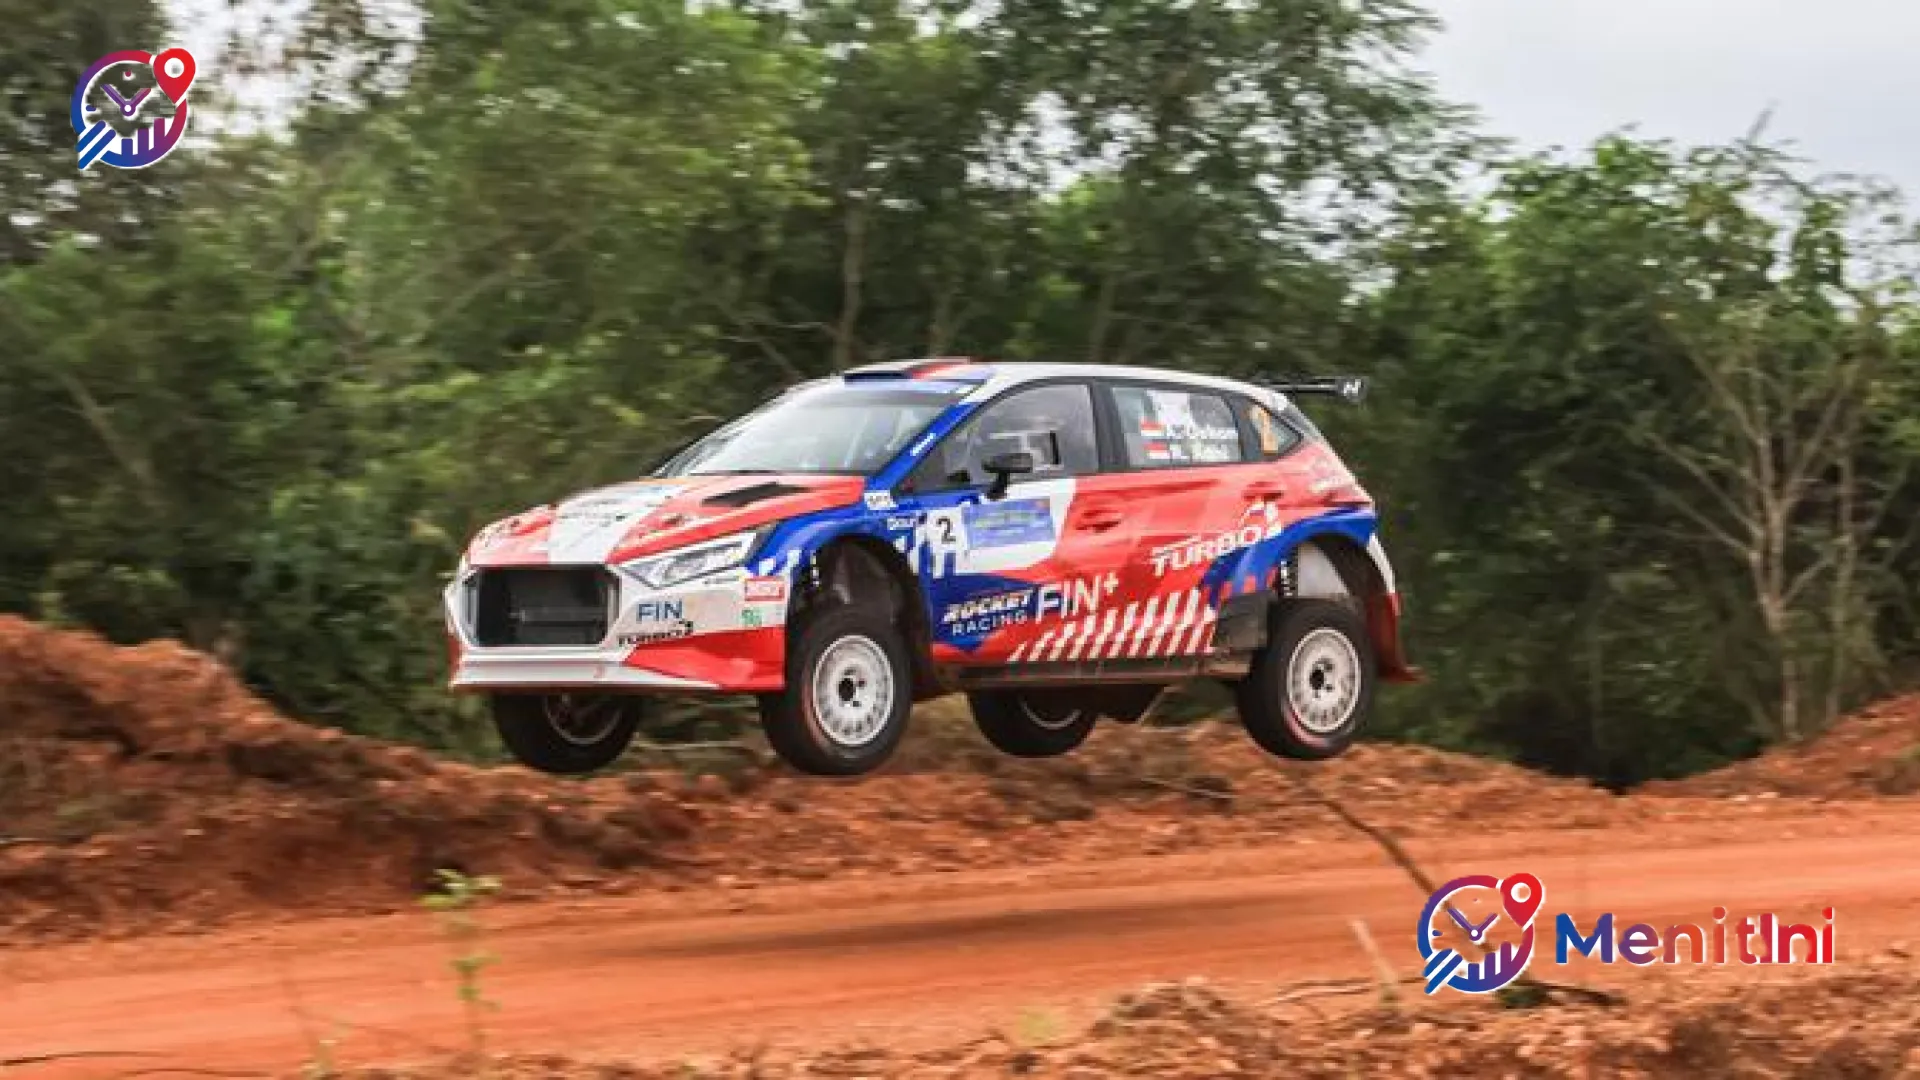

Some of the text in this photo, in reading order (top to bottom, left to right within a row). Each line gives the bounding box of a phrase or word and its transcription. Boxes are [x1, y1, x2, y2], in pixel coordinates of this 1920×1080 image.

[936, 516, 957, 544] 2
[1152, 525, 1262, 577] TURBO
[943, 588, 1034, 623] ROCKET
[952, 609, 1028, 636] RACING
